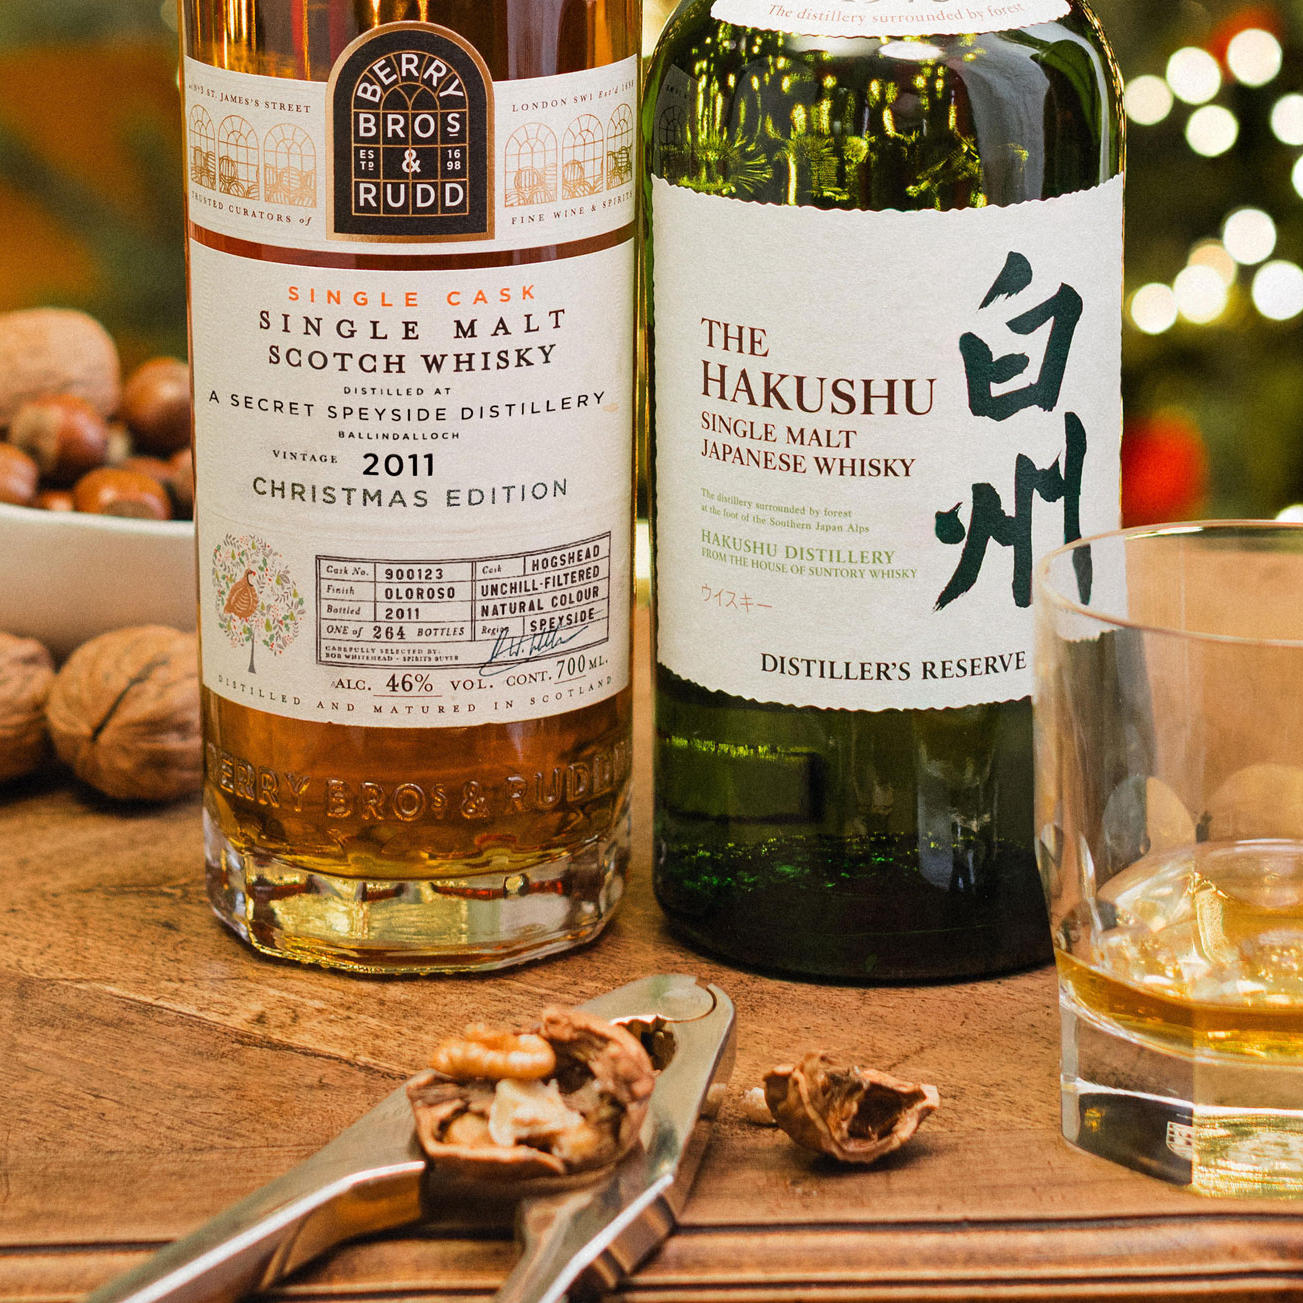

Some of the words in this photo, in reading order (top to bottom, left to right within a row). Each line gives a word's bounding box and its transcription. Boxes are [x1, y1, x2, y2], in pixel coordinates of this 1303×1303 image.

[768, 3, 793, 19] The
[795, 6, 867, 25] distillery
[872, 7, 963, 24] surrounded
[967, 6, 984, 23] by
[987, 1, 1026, 19] forest
[356, 54, 464, 102] BERRY
[220, 92, 260, 107] JAMES'S
[265, 101, 311, 113] STREET
[512, 97, 568, 112] LONDON
[401, 149, 421, 173] &
[359, 183, 464, 208] RUDD
[228, 205, 291, 223] CURATORS
[511, 213, 545, 225] FINE
[553, 207, 585, 219] WINE
[287, 285, 419, 308] SINGLE
[446, 284, 537, 306] CASK
[258, 309, 420, 340] SINGLE
[453, 309, 567, 339] MALT
[700, 317, 770, 358] THE
[267, 345, 406, 374] SCOTCH
[422, 344, 557, 374] WHISKY
[342, 386, 425, 396] DISTILLED
[433, 387, 452, 396] AT
[701, 359, 938, 416] HAKUSHU
[208, 390, 220, 405] A
[230, 393, 315, 418] SECRET
[327, 404, 447, 422] SPEYSIDE
[460, 390, 606, 421] DISTILLERY
[337, 429, 461, 441] BALLINDALLOCH
[701, 411, 778, 443] SINGLE
[785, 426, 858, 449] MALT
[933, 250, 1093, 613] 白州
[272, 448, 339, 464] VINTAGE
[361, 452, 435, 478] 2011
[701, 439, 808, 476] JAPANESE
[815, 456, 917, 479] WHISKY
[252, 476, 429, 509] CHRISTMAS
[446, 478, 568, 508] EDITION
[701, 487, 715, 500] The
[716, 493, 752, 509] distillery
[755, 502, 806, 515] surrounded
[809, 506, 820, 518] by
[823, 508, 852, 518] forest
[752, 515, 766, 525] the
[770, 517, 812, 530] Southern
[815, 521, 843, 533] Japan
[847, 523, 870, 534] Alps
[532, 544, 600, 572] HOGSHEAD
[701, 529, 778, 557] HAKUSHU
[785, 545, 896, 565] DISTILLERY
[384, 568, 444, 580] 900123
[701, 548, 727, 563] FROM
[730, 554, 749, 567] THE
[751, 559, 788, 574] HOUSE
[790, 565, 806, 575] OF
[808, 566, 866, 579] SUNTORY
[869, 568, 918, 579] WHISKY
[384, 586, 455, 600] OLOROSO
[481, 565, 600, 597] UNCHILL-FILTERED
[326, 604, 361, 615] Bottled
[481, 598, 544, 617] NATURAL
[551, 585, 599, 608] COLOUR
[701, 583, 773, 614] ウイスキー
[385, 607, 420, 620] 2011
[530, 607, 595, 633] SPEYSIDE
[326, 625, 349, 635] ONE
[372, 626, 406, 640] 264
[417, 627, 465, 637] BOTTLES
[334, 677, 373, 692] ALC.
[384, 673, 434, 694] 46%
[450, 677, 494, 692] VOL.
[505, 670, 552, 688] CONT.
[555, 654, 587, 679] 700
[760, 651, 911, 683] DISTILLER'S
[920, 650, 1028, 681] RESERVE
[217, 674, 301, 706] DISTILLED
[316, 700, 356, 712] AND
[373, 703, 477, 715] MATURED
[493, 700, 514, 711] IN
[529, 675, 614, 706] SCOTLAND
